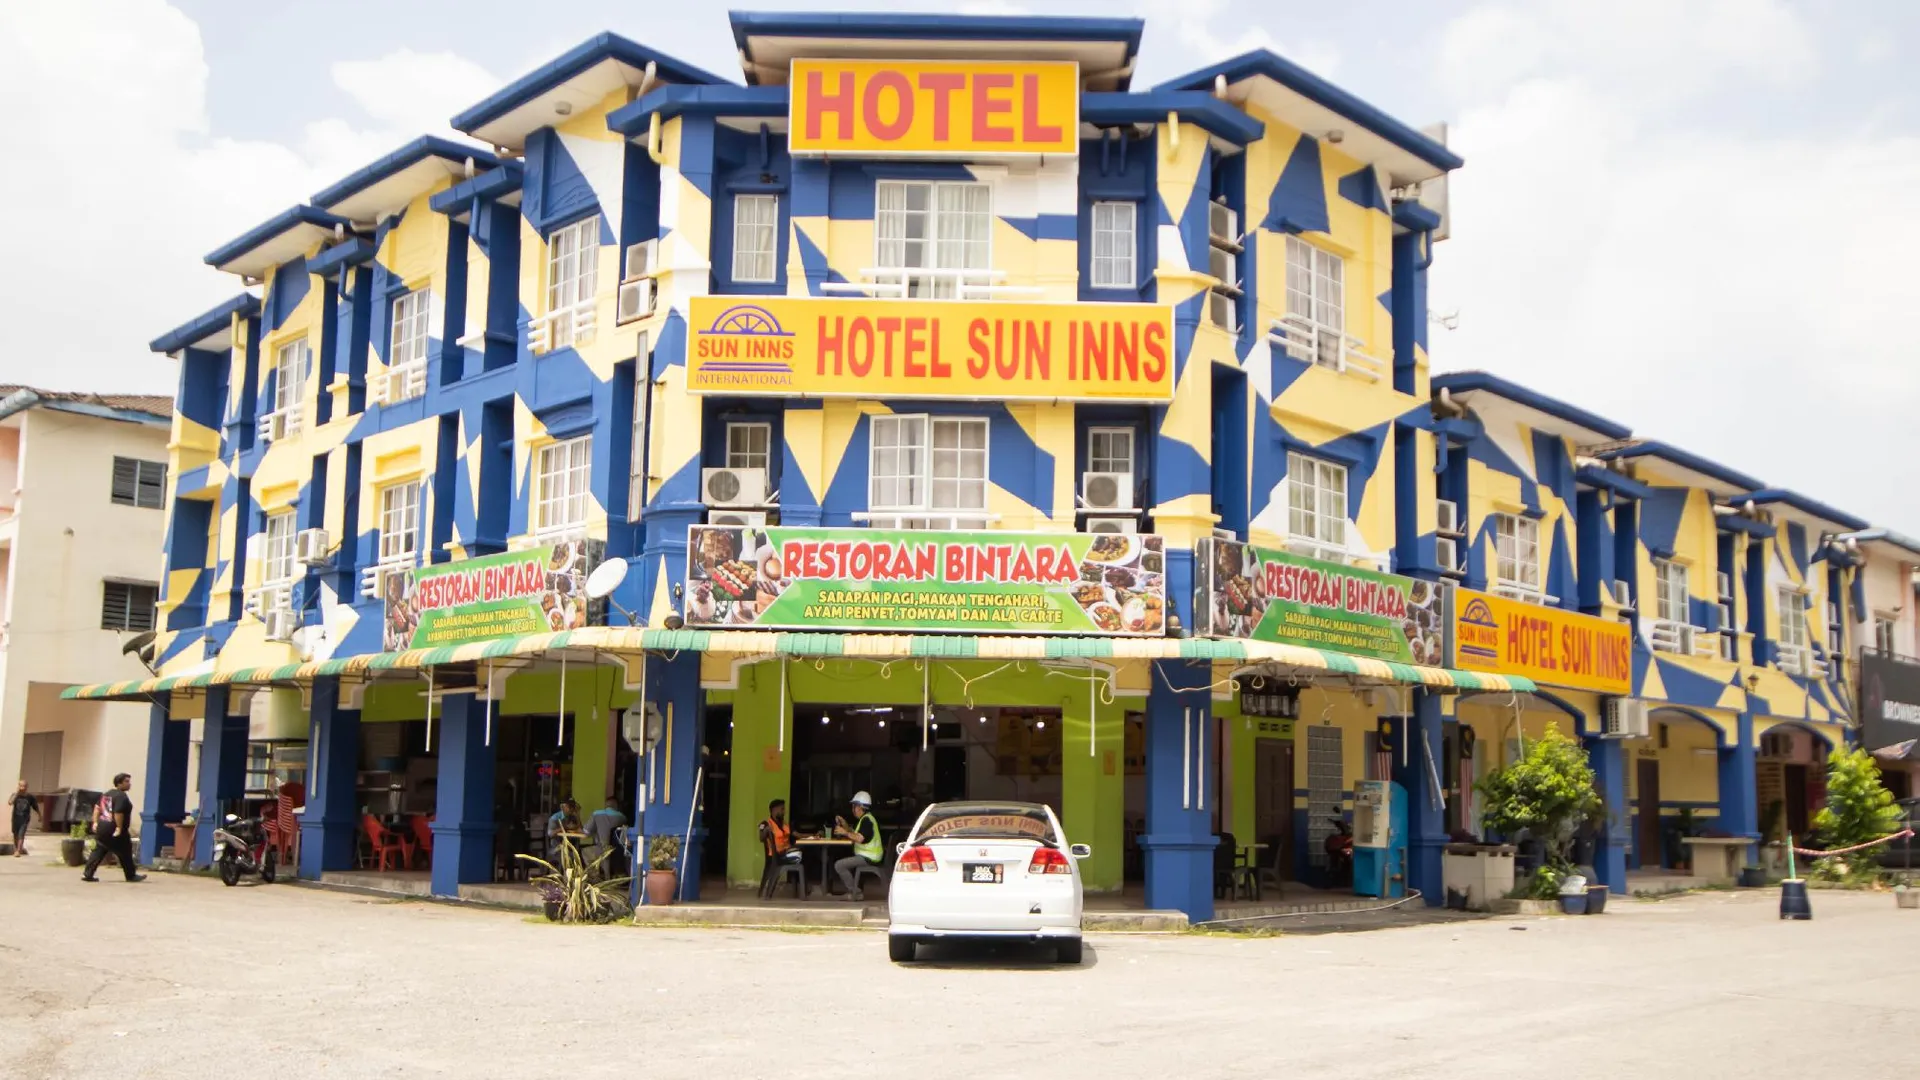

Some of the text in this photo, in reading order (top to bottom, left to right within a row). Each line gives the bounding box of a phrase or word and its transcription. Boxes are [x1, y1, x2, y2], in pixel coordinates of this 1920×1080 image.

[804, 69, 1062, 143] HOTEL
[698, 338, 794, 359] SUN INNS
[816, 315, 1166, 383] HOTEL SUN INNS
[696, 373, 793, 385] INTERNATIONAL
[419, 558, 545, 610] RESTORAN BINTARA
[782, 541, 1079, 584] RESTORAN BINTARA
[818, 590, 880, 604] SARAPAN
[969, 593, 1048, 608] TENGAHARI,
[1264, 561, 1408, 619] RESTORAN BINTARA
[804, 605, 843, 618] AYAM
[961, 608, 989, 621] DAN
[992, 609, 1017, 622] ALA
[1020, 609, 1063, 623] CARTE
[1458, 623, 1475, 642] SUN
[1507, 611, 1629, 682] HOTEL SUN INNS
